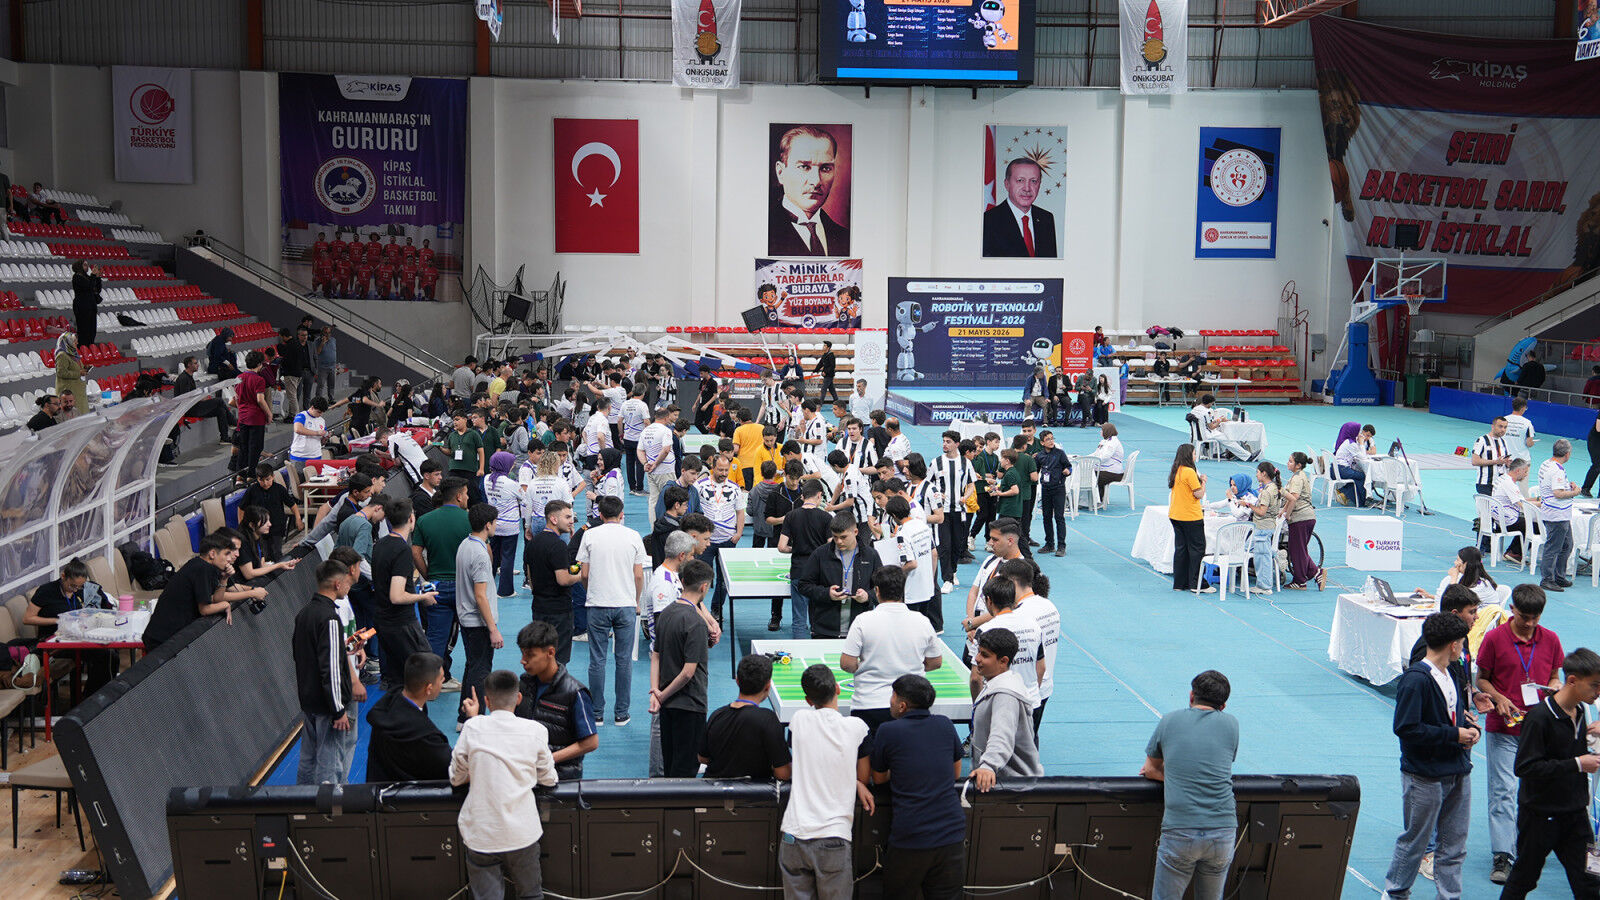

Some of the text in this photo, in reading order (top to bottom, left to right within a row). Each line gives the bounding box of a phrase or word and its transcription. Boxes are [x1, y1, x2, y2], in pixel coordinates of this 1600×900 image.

[1472, 60, 1528, 82] KİPAŞ
[370, 81, 402, 92] KİPAŞ
[318, 110, 431, 127] KAHRAMANMARAŞ'IN
[130, 125, 176, 137] TÜRKİYE
[332, 126, 418, 151] GURURU
[1446, 123, 1518, 166] ŞEHRİ
[383, 159, 411, 173] KİPAŞ
[383, 173, 425, 187] İSTİKLAL
[1359, 168, 1488, 210] BASKETBOL
[383, 190, 438, 202] BASKETBOL
[383, 204, 417, 216] TAKIMI
[1366, 211, 1532, 257] RUU İSTİKLAL
[776, 273, 844, 284] TARAFTARLAR
[791, 284, 830, 294] BURAYA
[791, 305, 831, 316] BURADA
[931, 301, 1043, 312] ROBOTİK VE TEKNOLOJİ
[944, 314, 993, 325] FESTİVALİ
[1002, 316, 1025, 324] 2026
